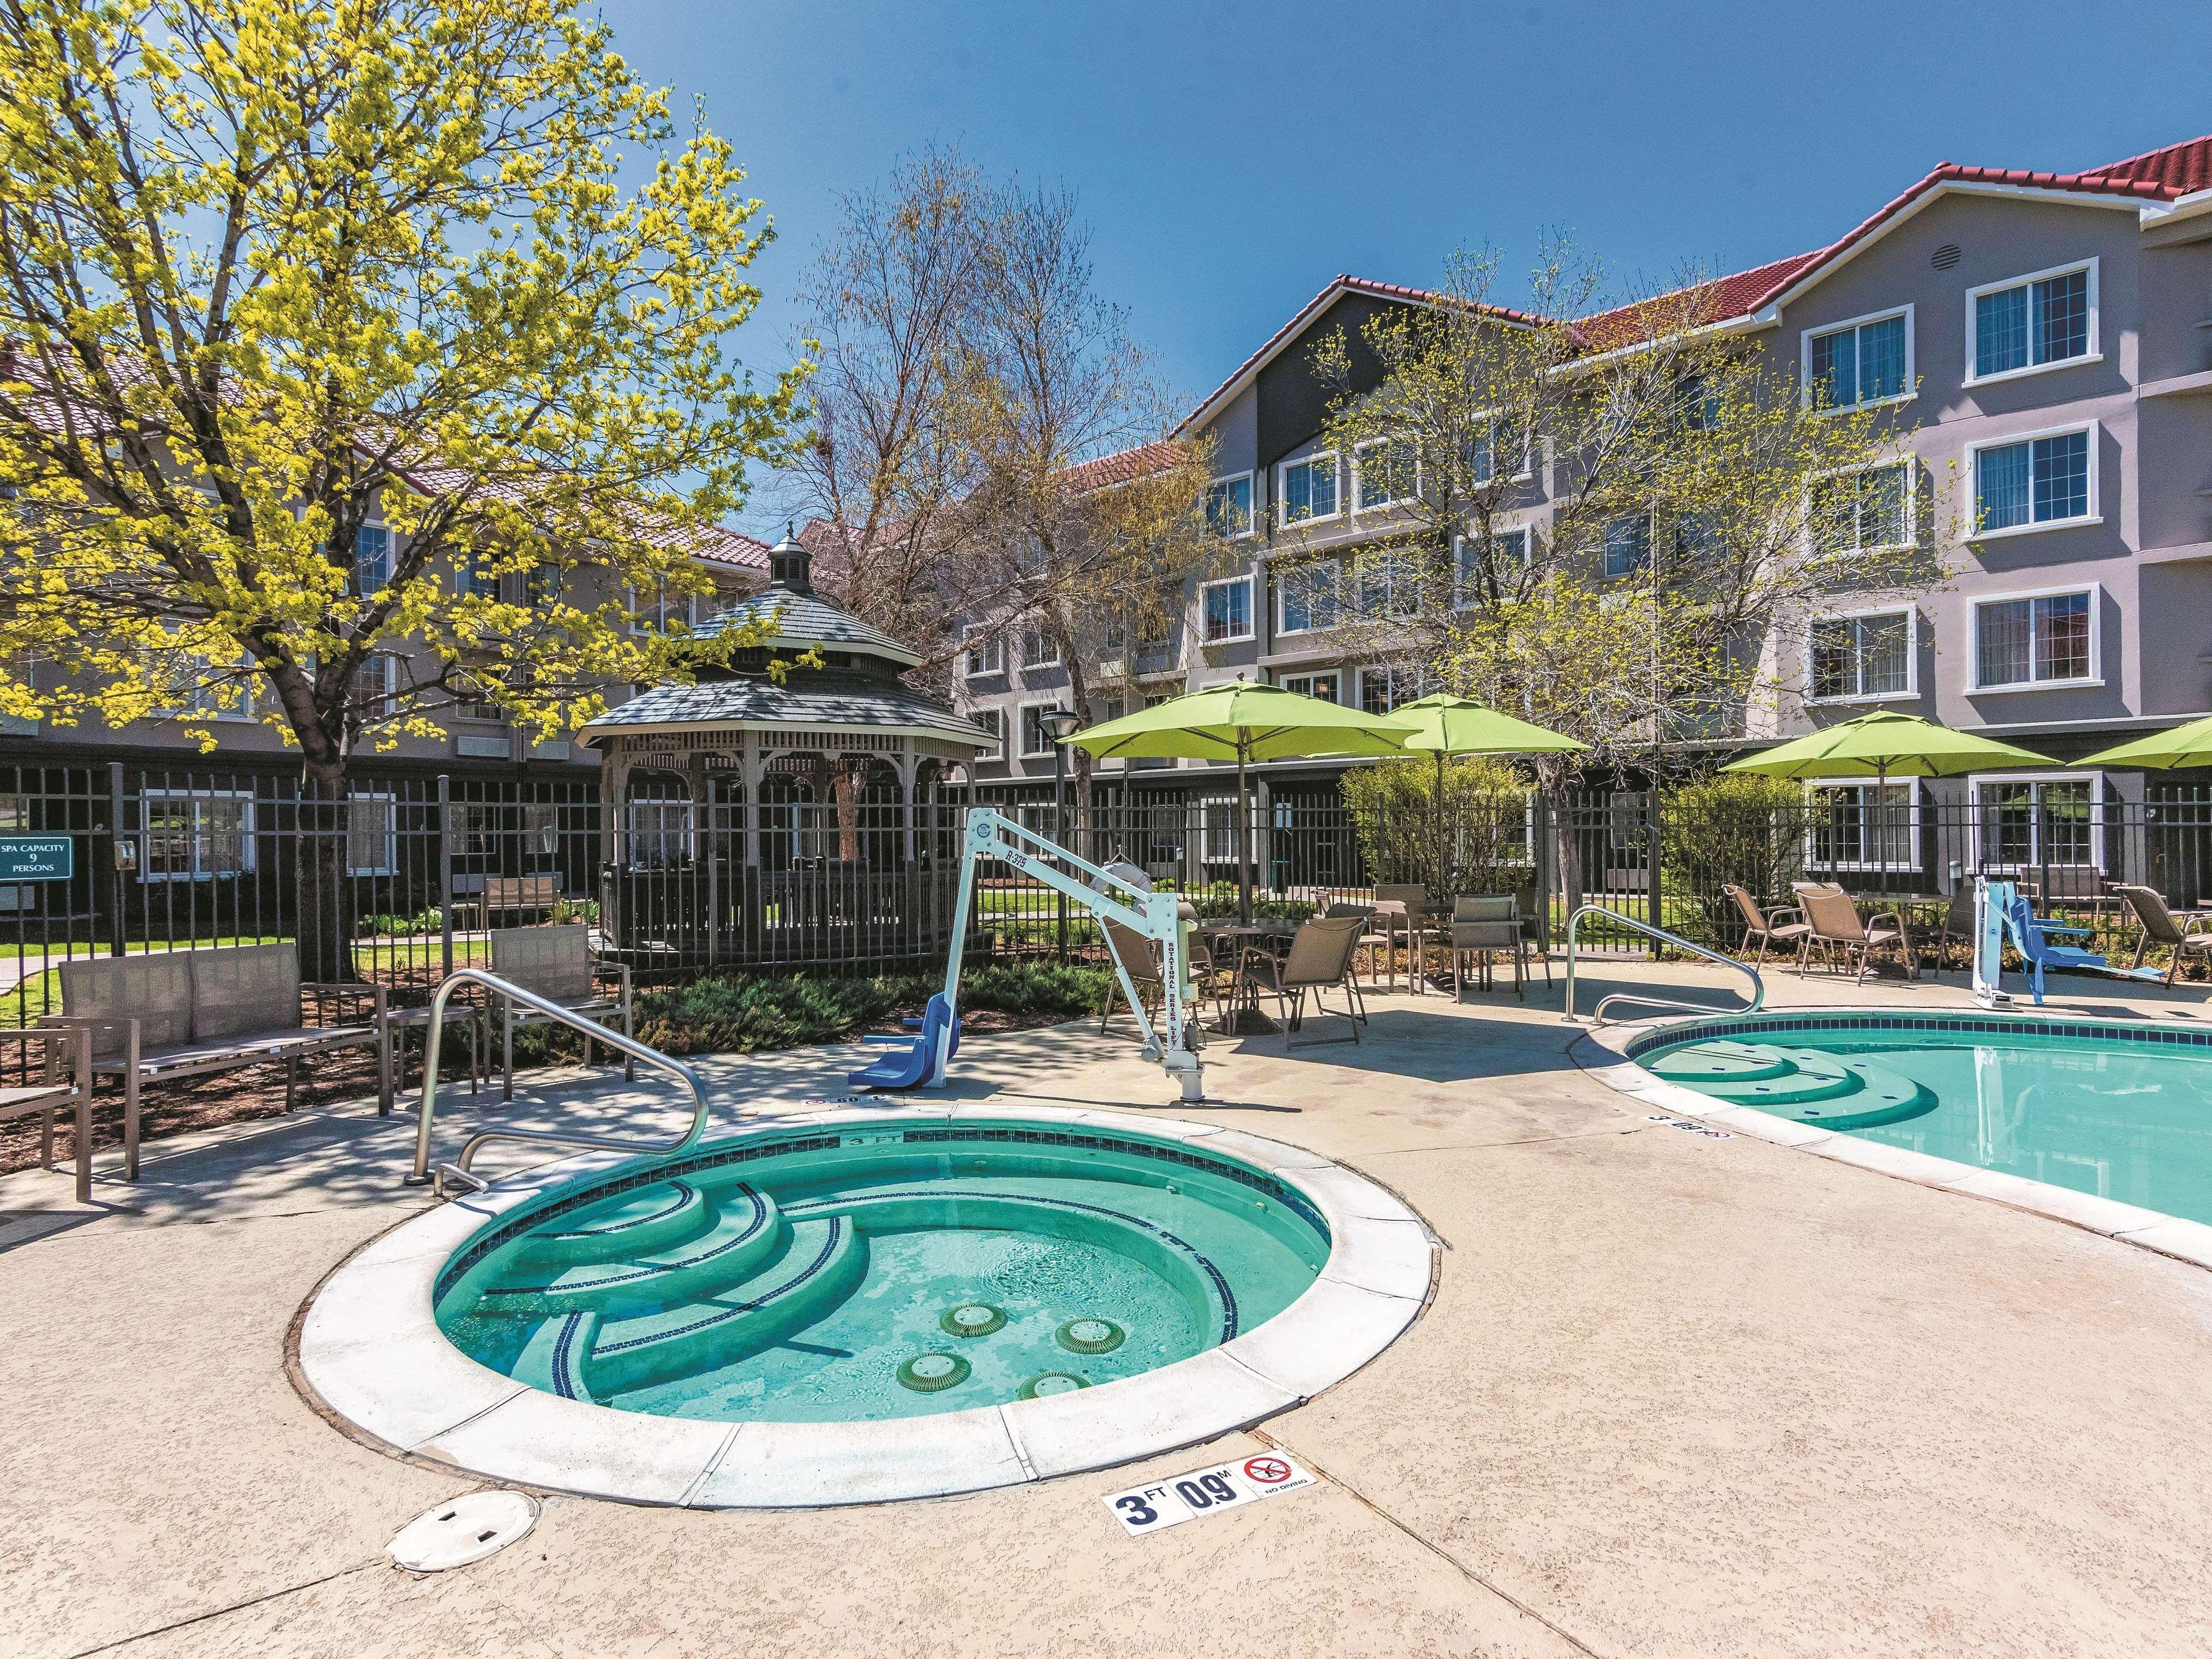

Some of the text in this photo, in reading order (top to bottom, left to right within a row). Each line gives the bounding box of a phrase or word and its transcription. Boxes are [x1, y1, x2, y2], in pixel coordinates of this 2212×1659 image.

[29, 853, 37, 862] 9
[1005, 850, 1027, 868] R-375
[13, 864, 55, 872] PERSONS
[1279, 1479, 1308, 1490] DIVING
[1115, 1495, 1158, 1525] 3
[1143, 1486, 1166, 1501] FT
[1217, 1469, 1232, 1479] M
